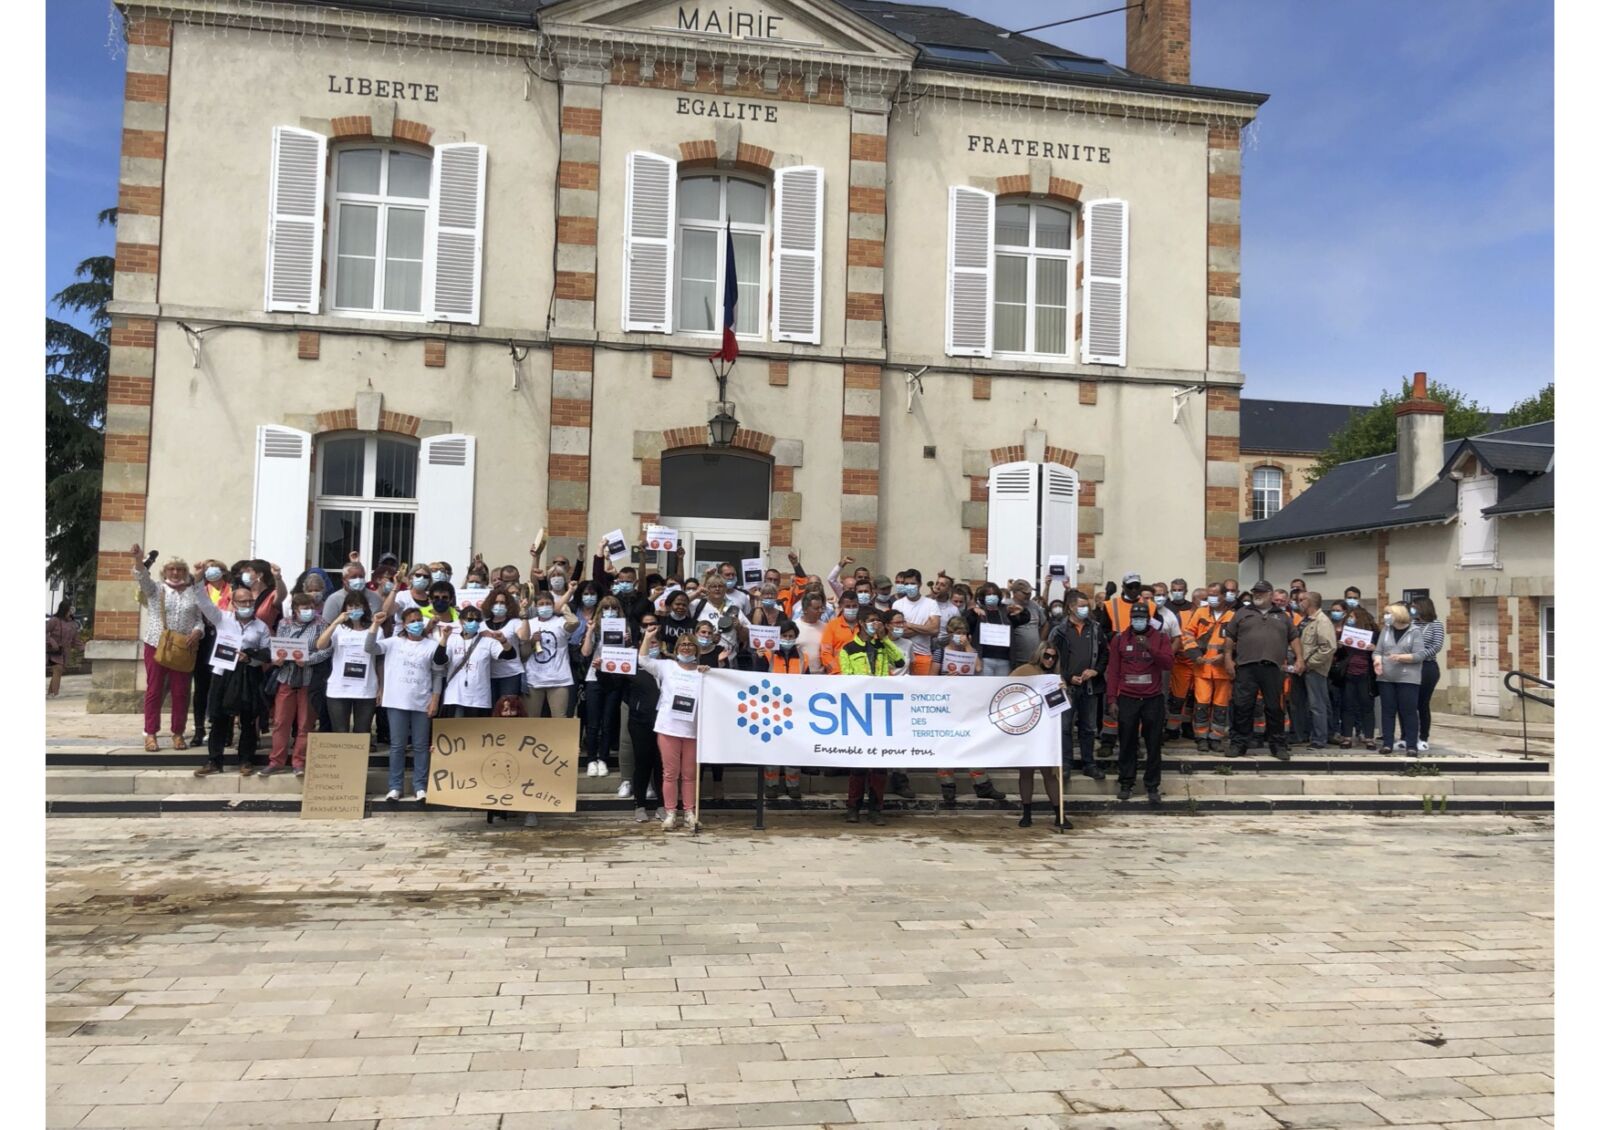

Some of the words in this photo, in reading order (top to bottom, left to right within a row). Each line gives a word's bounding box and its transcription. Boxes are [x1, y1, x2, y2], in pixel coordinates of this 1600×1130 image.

[327, 75, 439, 102] LIBERTE
[676, 97, 778, 123] EGALITE
[967, 135, 1111, 164] FRATERNITE
[911, 693, 951, 702] SYNDICAT
[808, 692, 904, 737] SNT
[911, 706, 951, 714] NATIONAL
[911, 717, 927, 726] DES
[436, 733, 466, 756] On
[481, 733, 507, 748] ne
[912, 729, 971, 738] TERRITORIAUX
[814, 743, 863, 755] Ensemble
[867, 747, 878, 755] et
[881, 748, 907, 757] pour
[433, 769, 478, 792] Plus
[480, 794, 514, 806] se
[521, 779, 562, 807] taire
